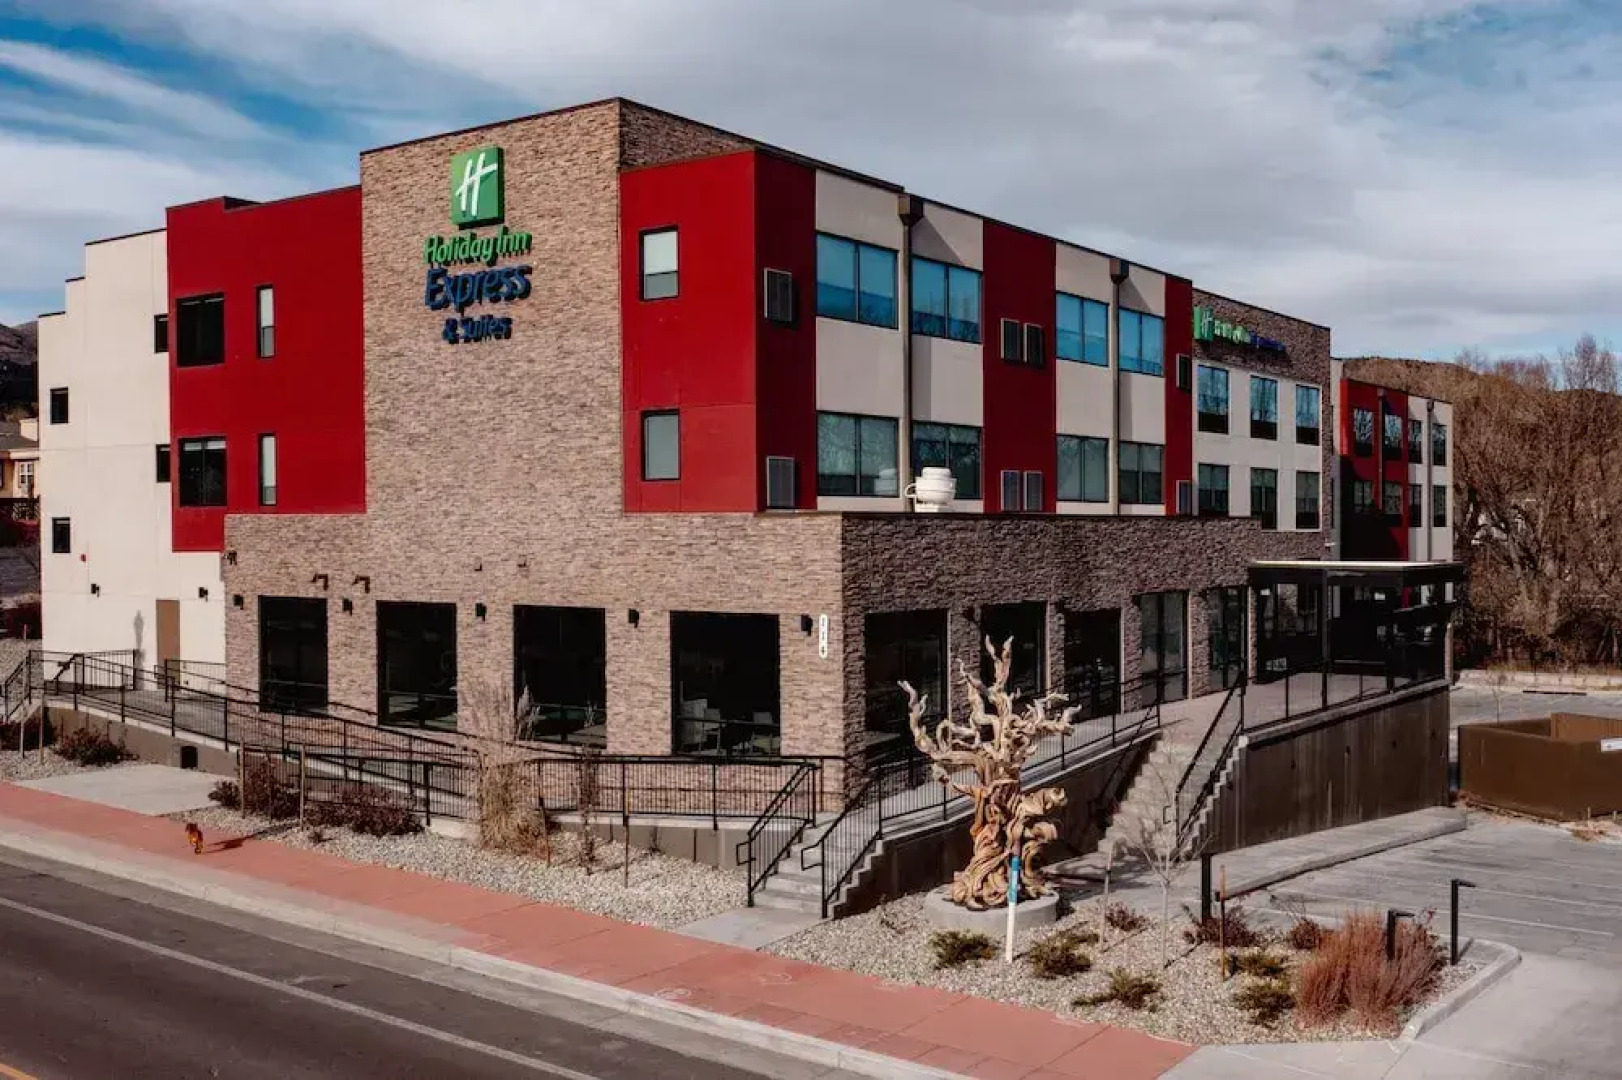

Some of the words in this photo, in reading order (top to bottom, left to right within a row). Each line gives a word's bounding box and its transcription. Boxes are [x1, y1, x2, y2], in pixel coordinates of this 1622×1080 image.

[455, 151, 498, 217] H
[424, 232, 495, 264] Holiday
[496, 227, 532, 256] Inn
[424, 266, 532, 312] Express
[442, 318, 459, 344] &
[461, 316, 513, 342] Suites
